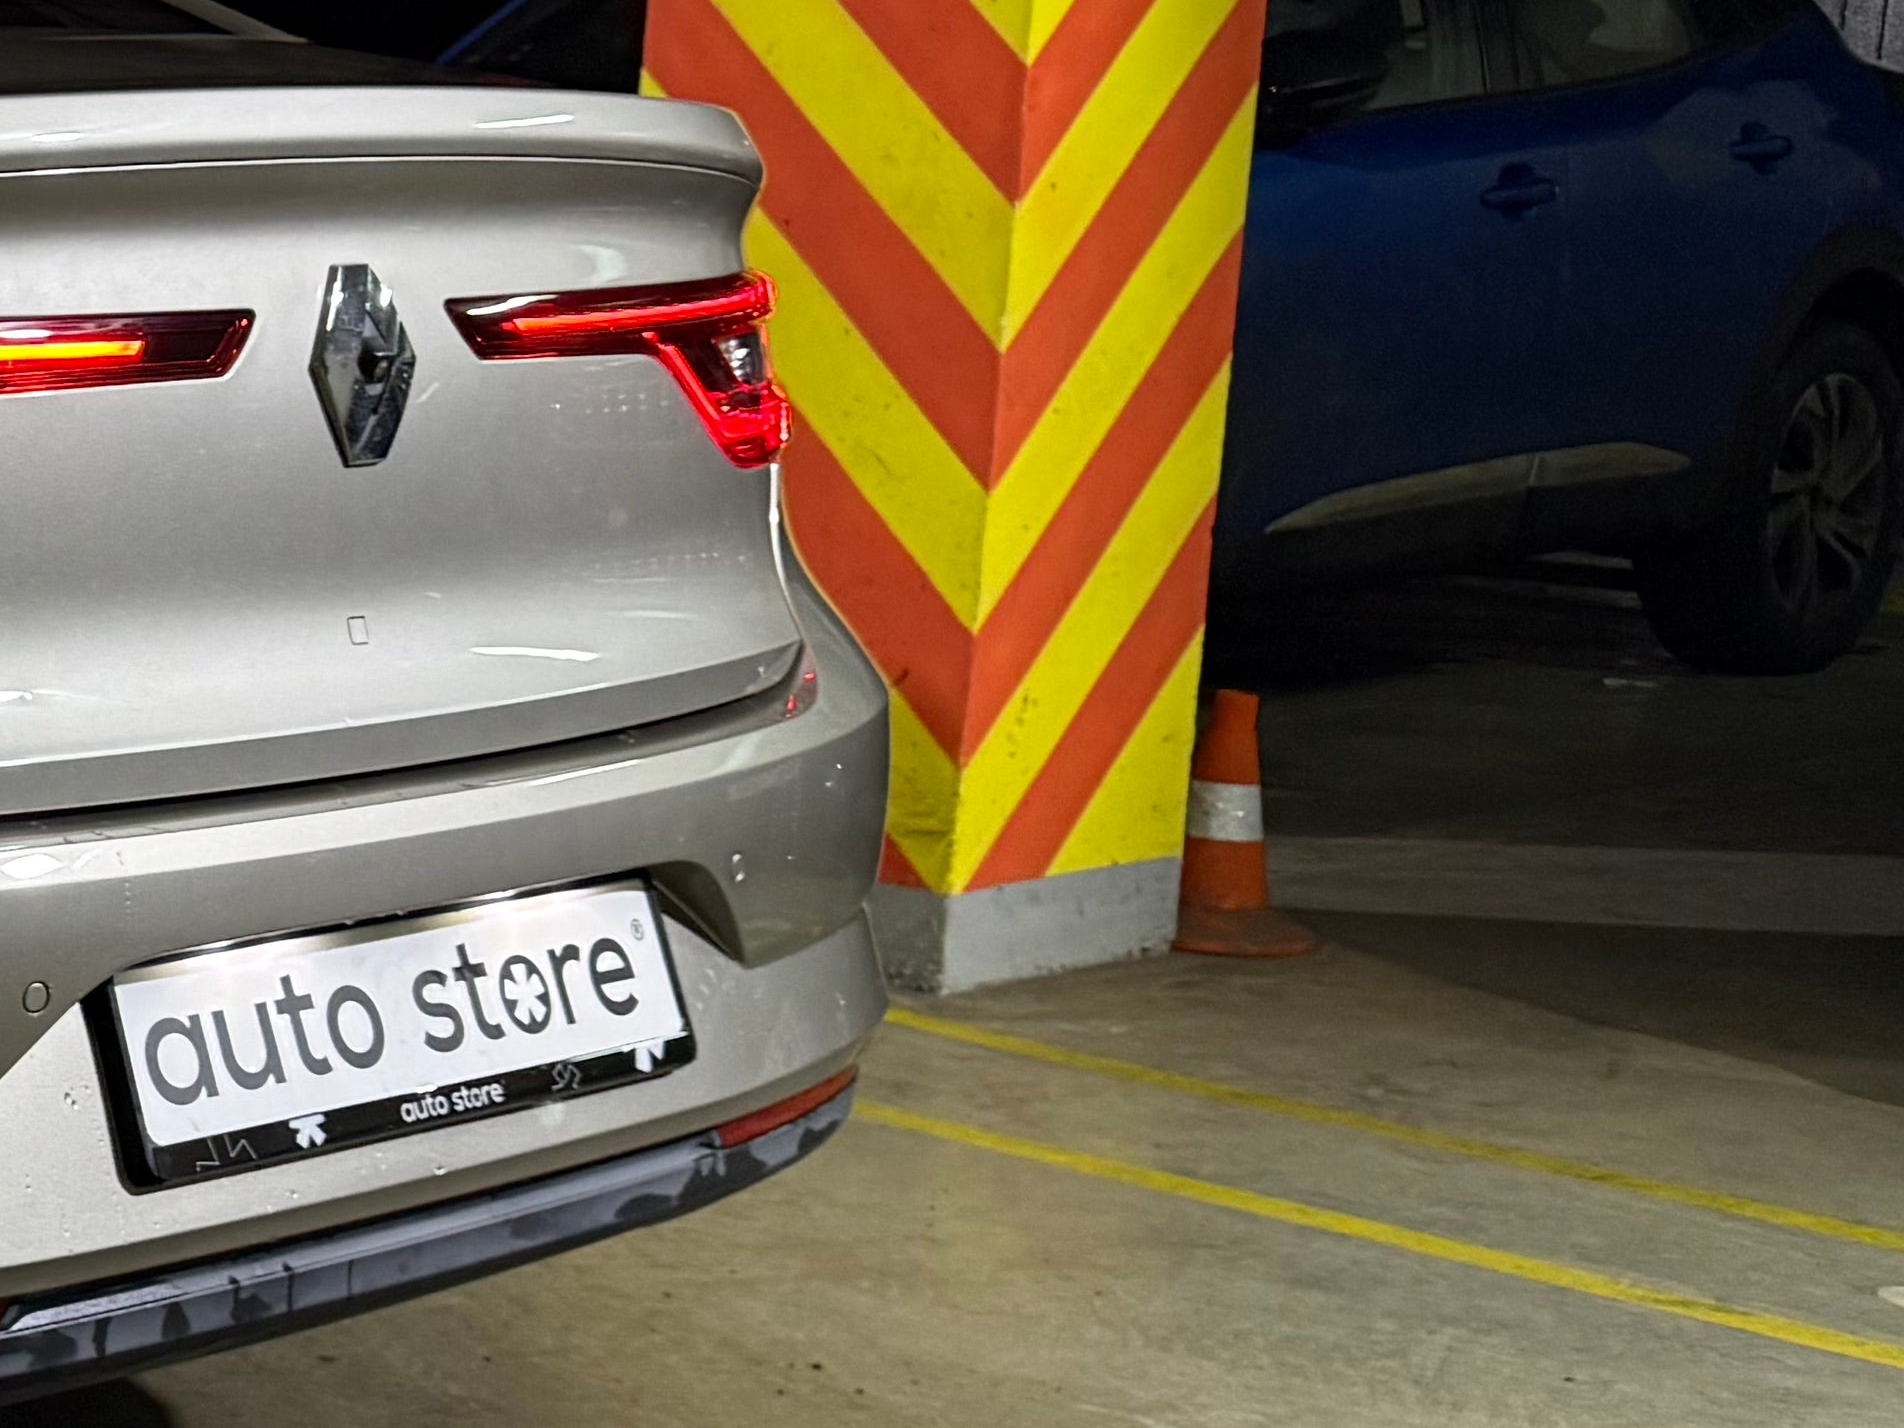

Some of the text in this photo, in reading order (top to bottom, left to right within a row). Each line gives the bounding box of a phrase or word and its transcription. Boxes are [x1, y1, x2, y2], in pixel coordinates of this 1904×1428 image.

[145, 937, 639, 1106] auto store
[400, 1082, 506, 1123] auto store
